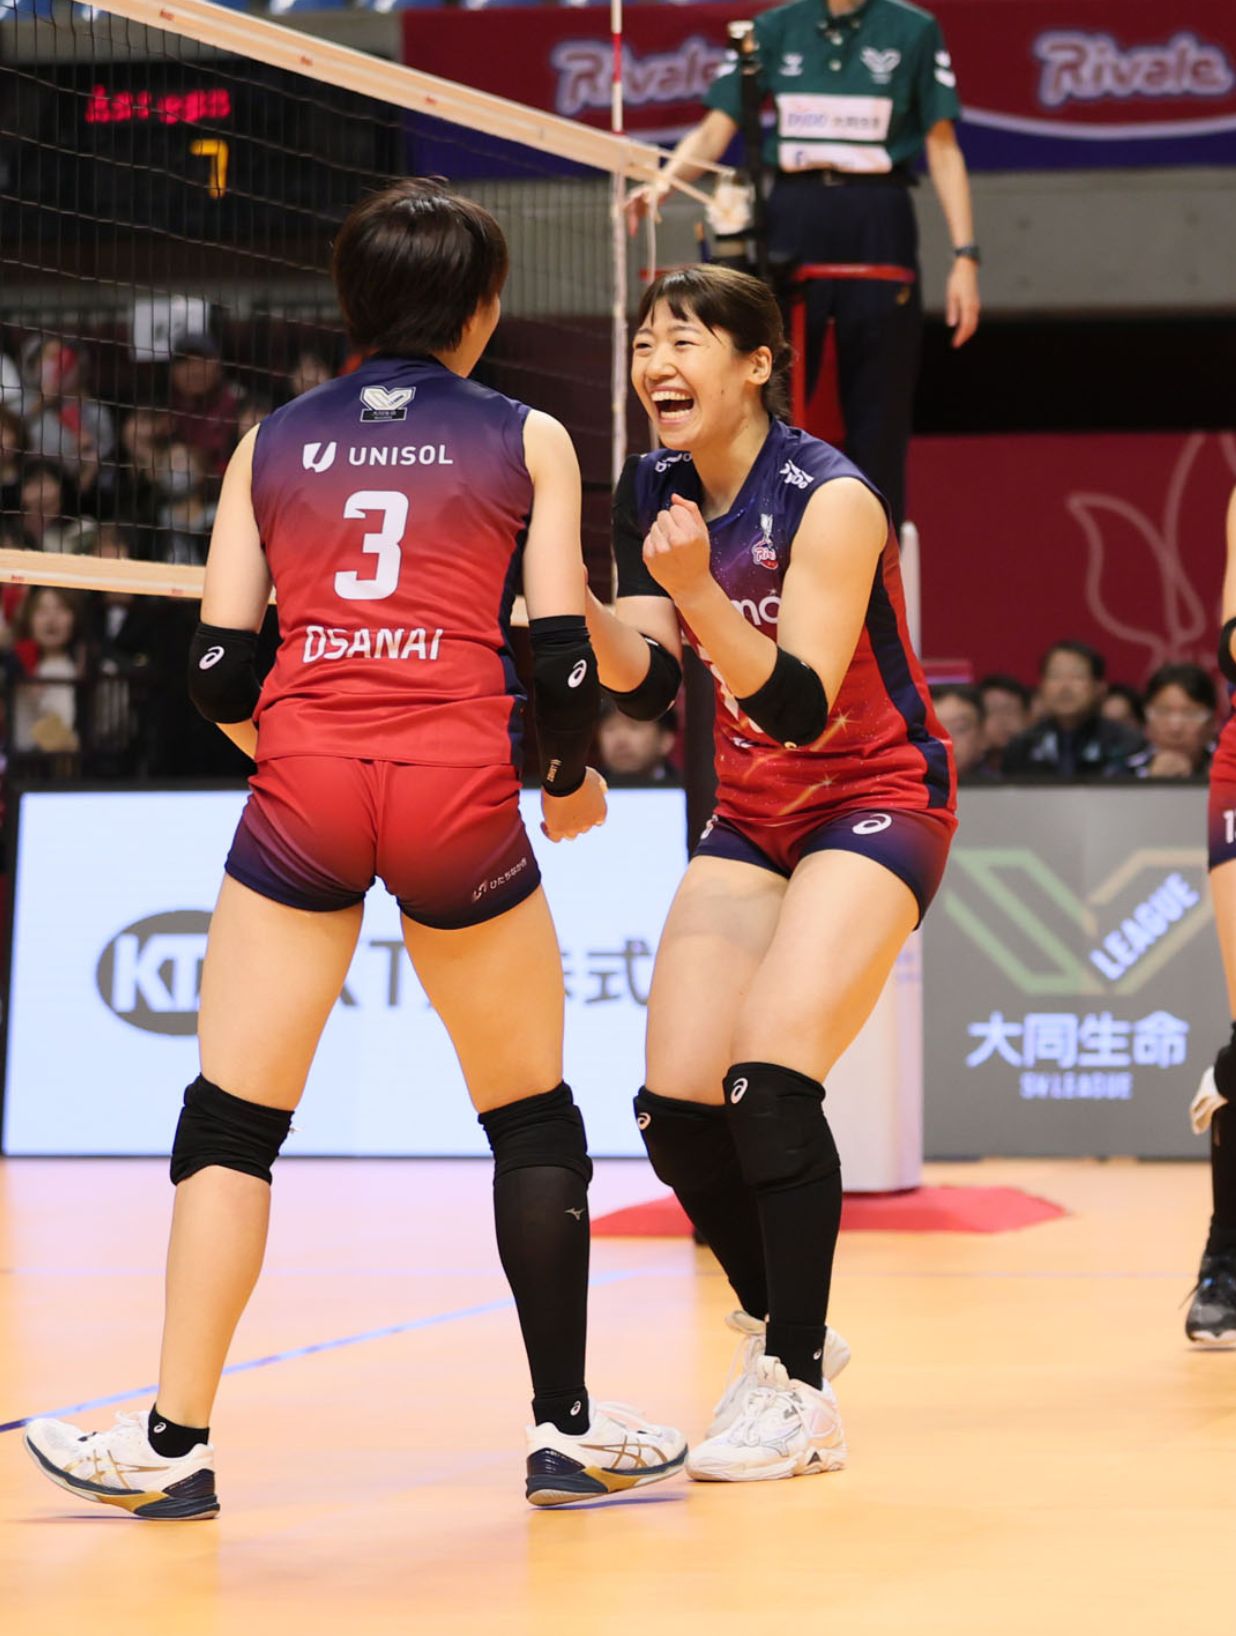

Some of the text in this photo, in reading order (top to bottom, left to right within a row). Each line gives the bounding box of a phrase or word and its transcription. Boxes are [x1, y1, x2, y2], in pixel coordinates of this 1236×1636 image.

[555, 39, 724, 110] Rvale
[1037, 33, 1231, 104] Rivale
[190, 140, 229, 199] 7
[349, 444, 454, 466] UNISOL
[334, 490, 409, 600] 3
[1223, 809, 1236, 843] 1
[1089, 872, 1200, 981] LEAGUE
[112, 934, 208, 1012] KT
[966, 1010, 1190, 1069] 大同生命
